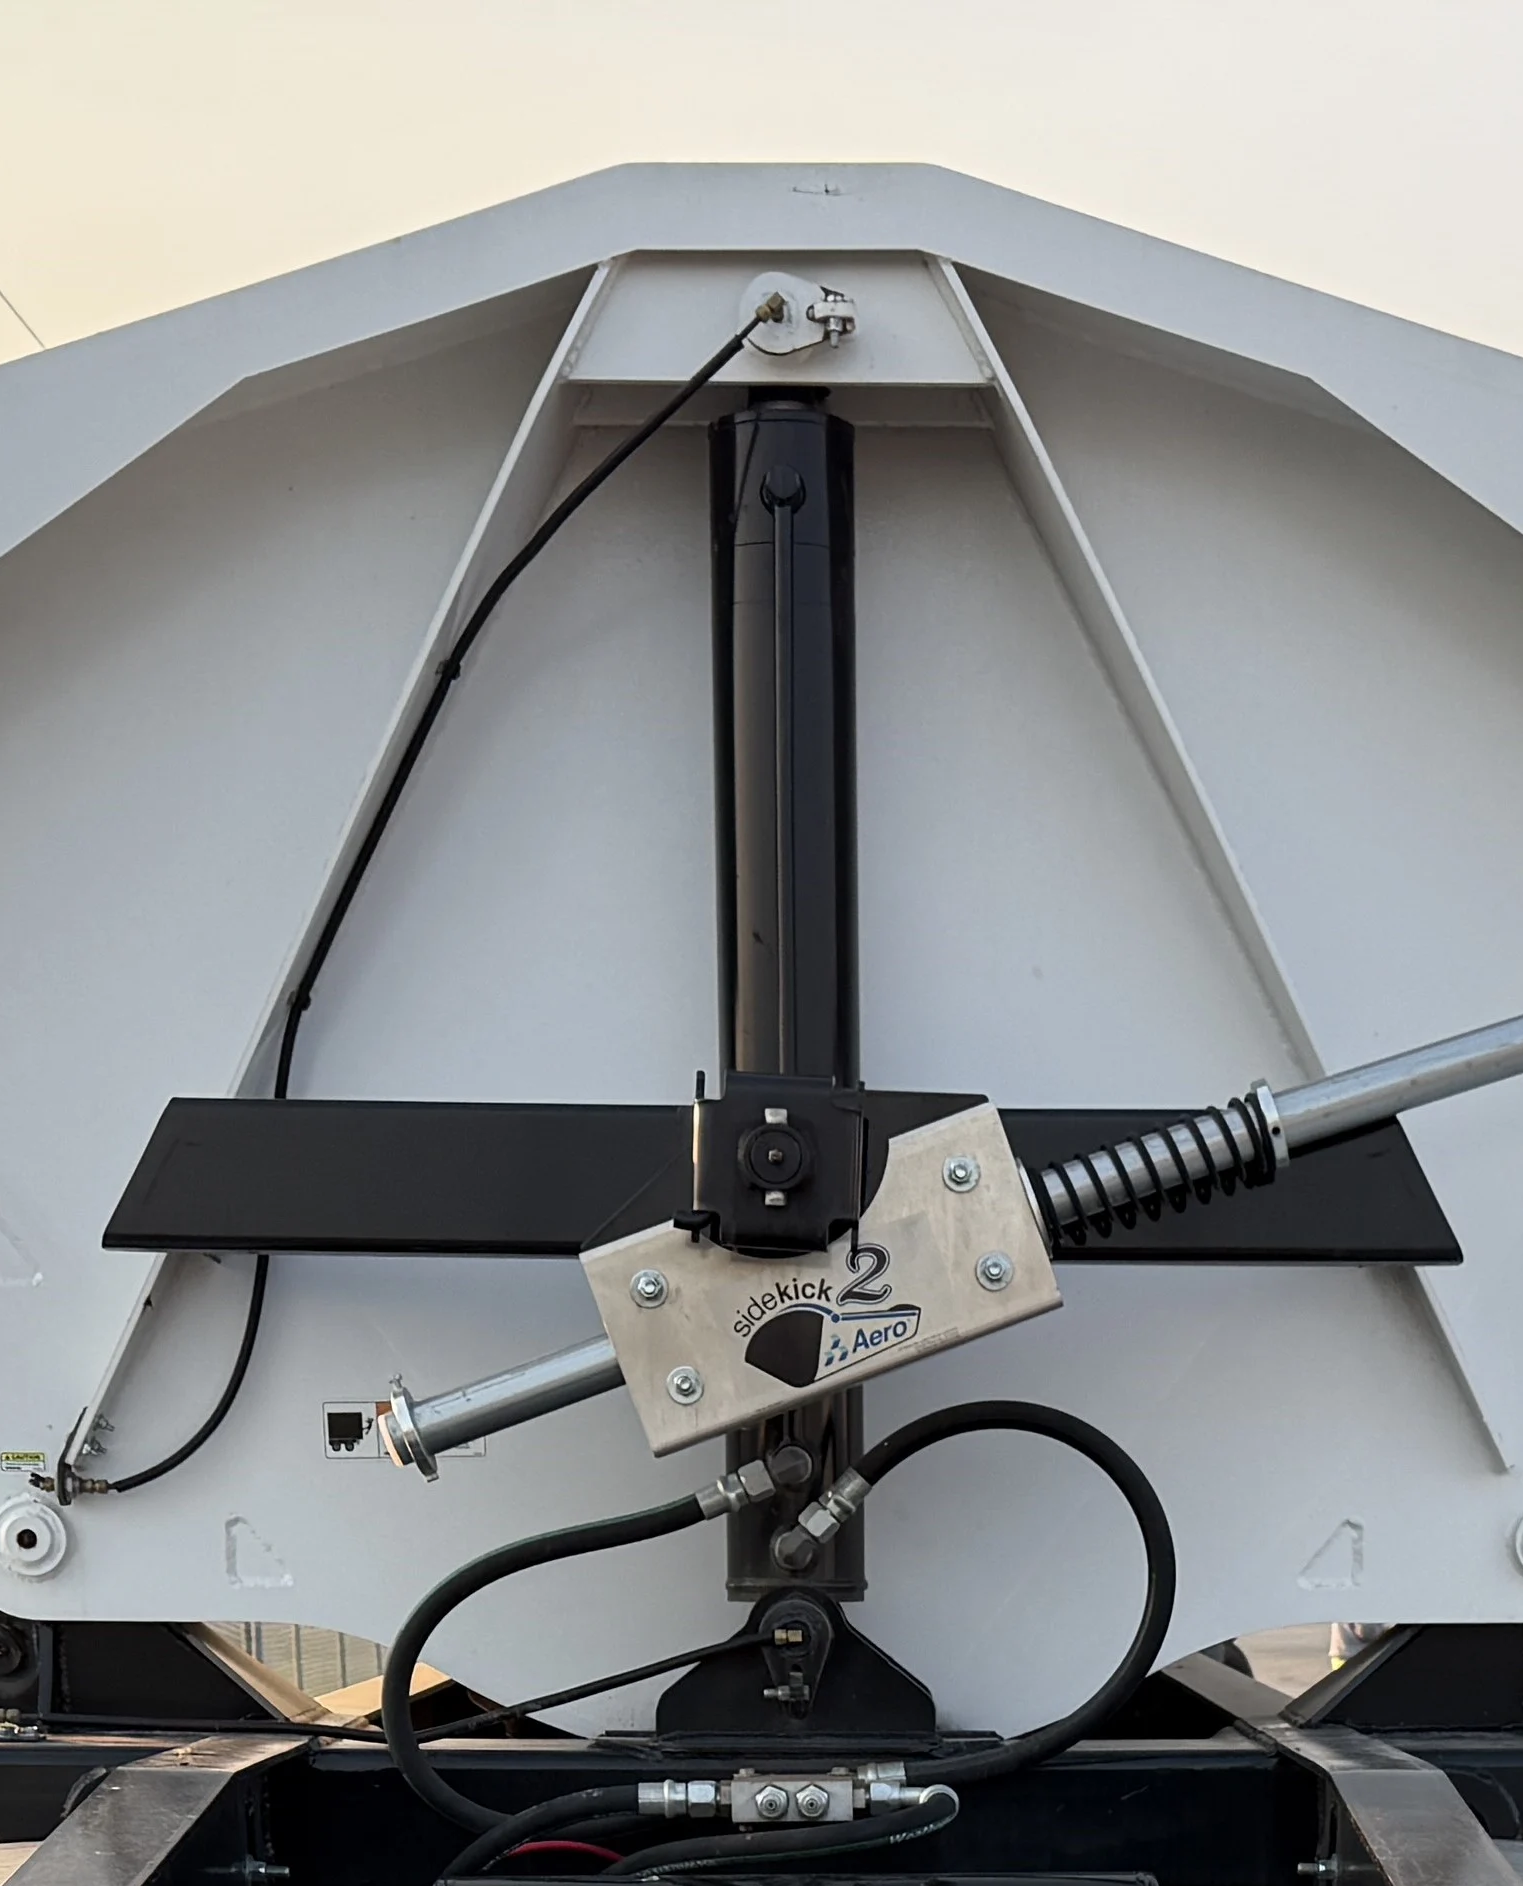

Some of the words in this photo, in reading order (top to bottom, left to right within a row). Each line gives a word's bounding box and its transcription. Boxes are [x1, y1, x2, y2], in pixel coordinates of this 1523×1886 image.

[733, 1277, 834, 1338] sidekick
[836, 1243, 893, 1307] 2
[851, 1319, 908, 1354] Aero
